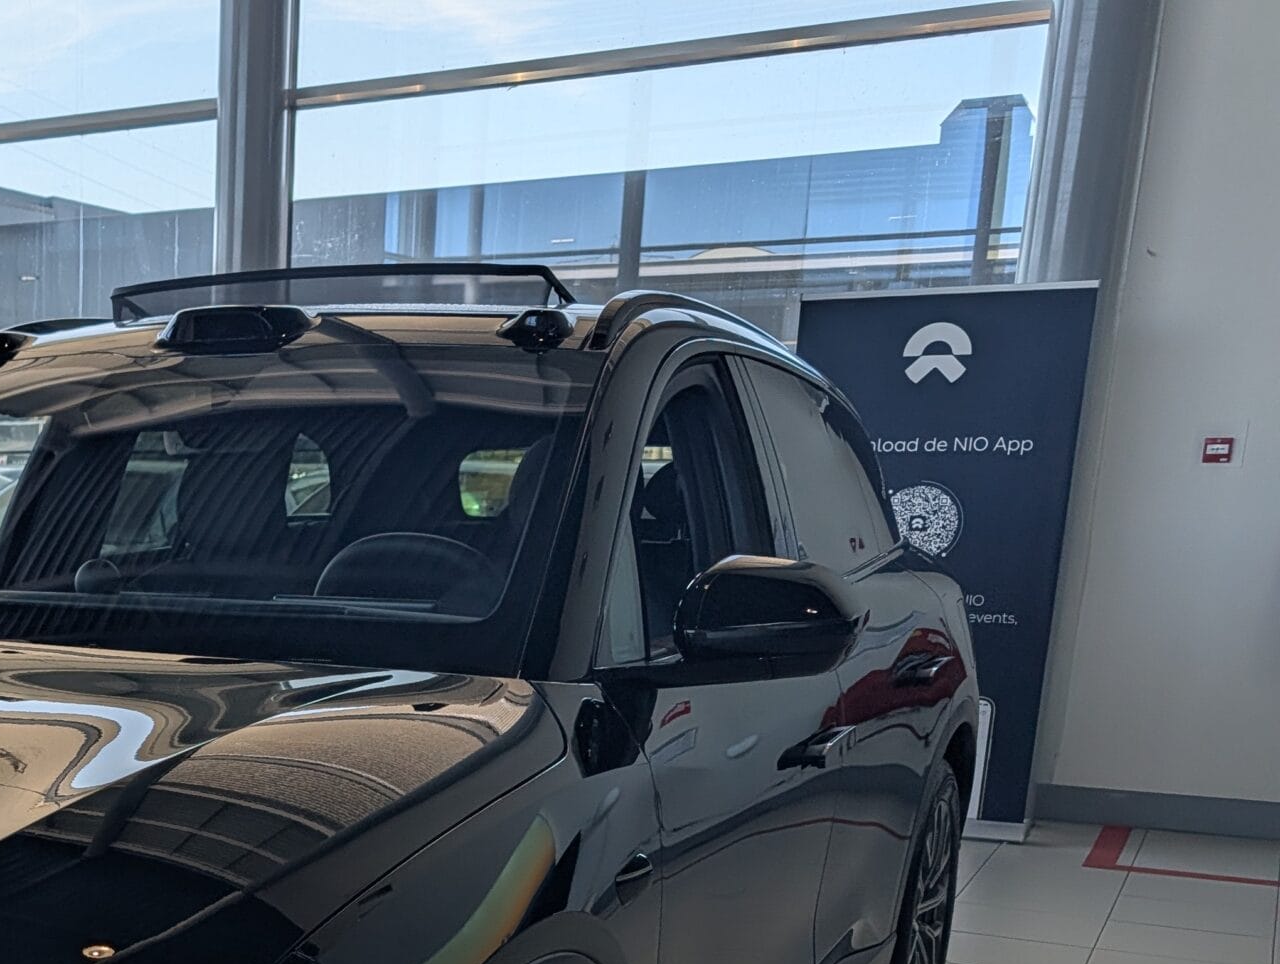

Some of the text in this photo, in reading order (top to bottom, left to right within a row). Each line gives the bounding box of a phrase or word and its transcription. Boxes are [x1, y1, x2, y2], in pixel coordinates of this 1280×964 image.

[924, 437, 948, 452] de
[953, 436, 989, 452] NIO
[993, 436, 1034, 455] App
[965, 594, 985, 606] IO
[968, 613, 1018, 625] events,
